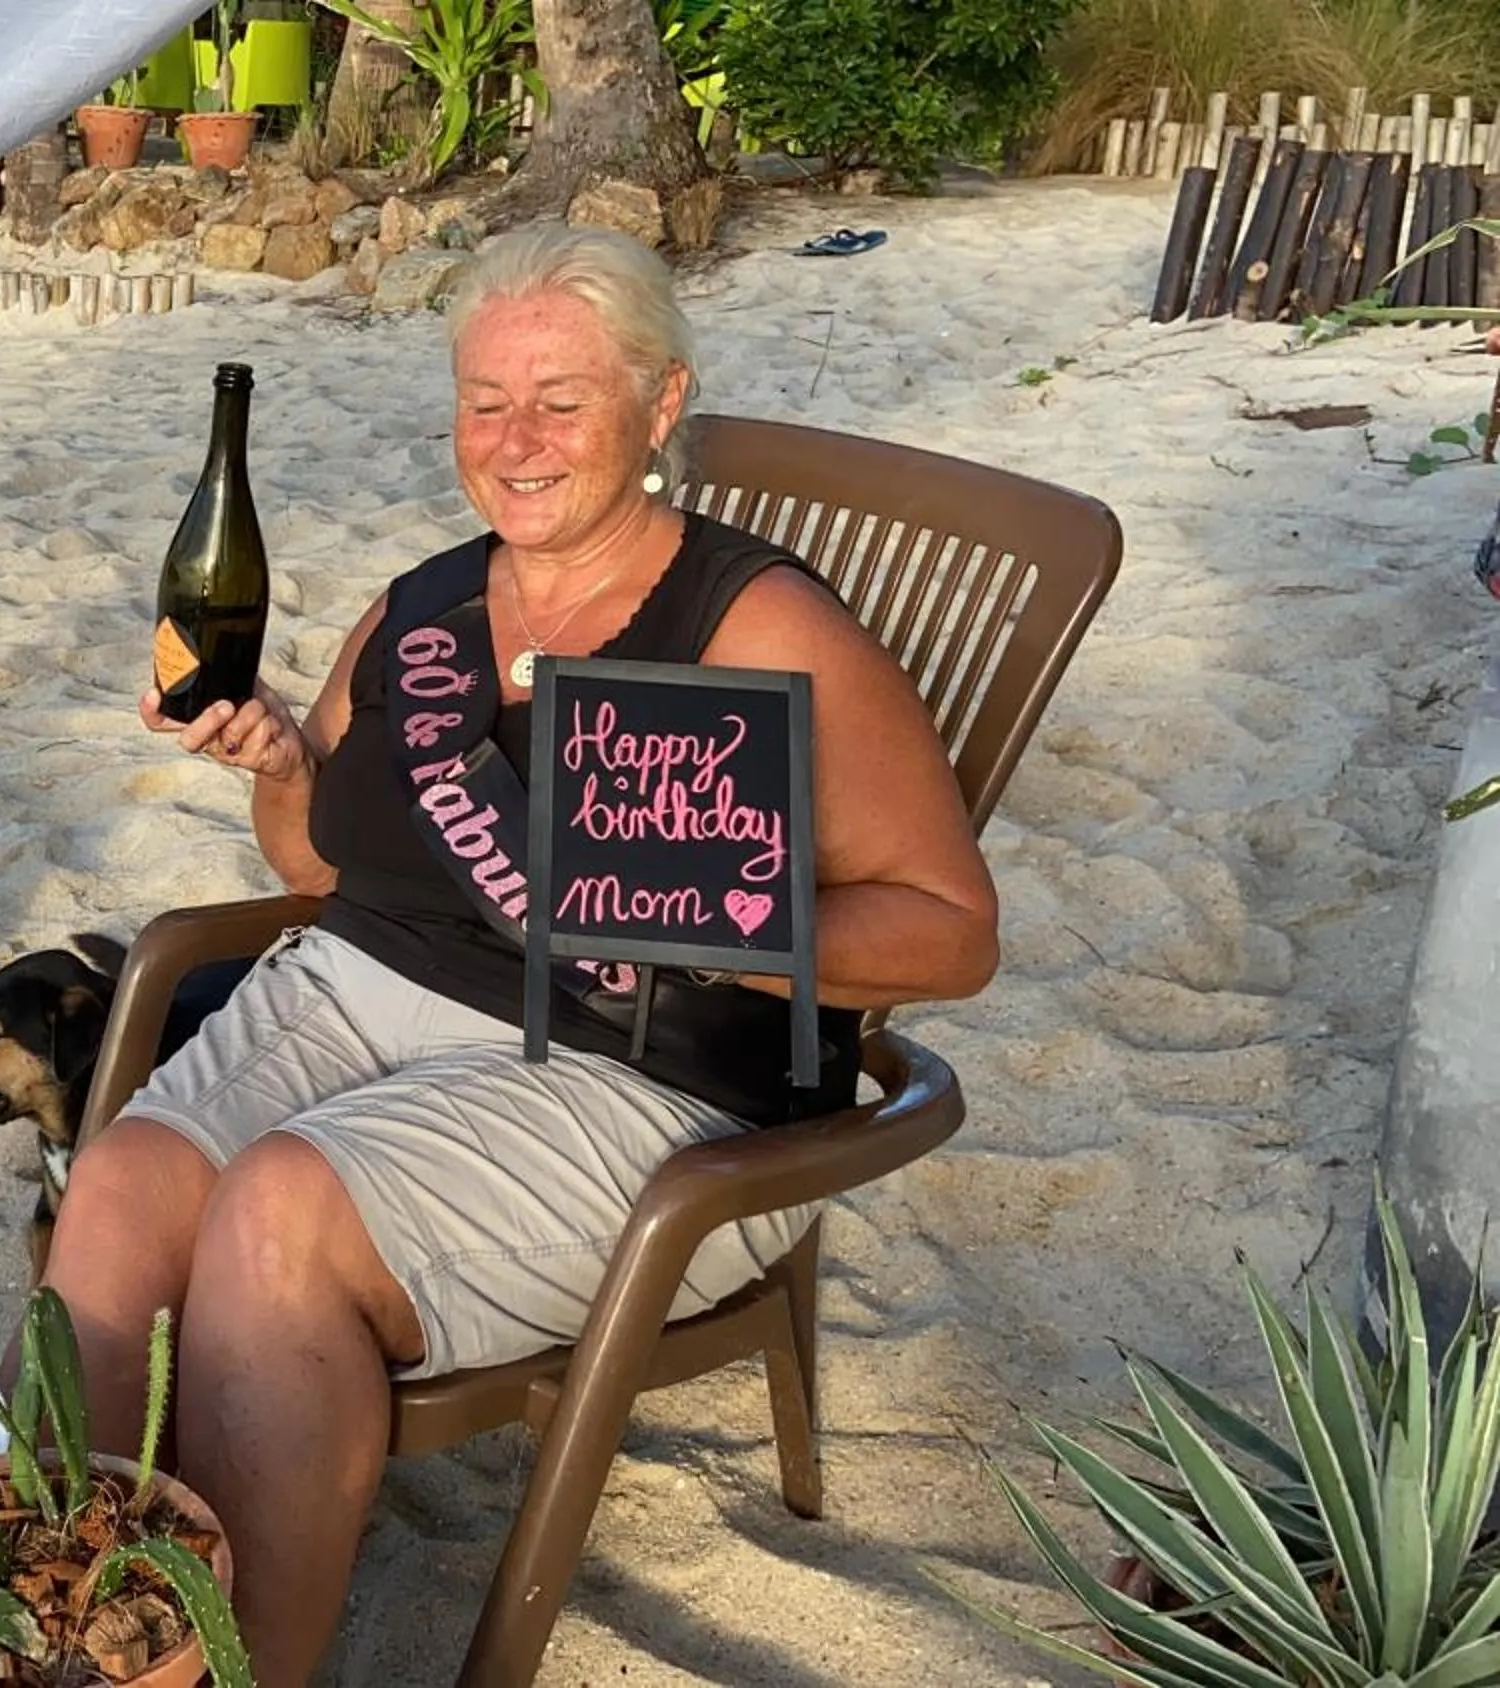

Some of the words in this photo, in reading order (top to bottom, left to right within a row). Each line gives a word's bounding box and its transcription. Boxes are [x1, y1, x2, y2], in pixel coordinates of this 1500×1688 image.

[397, 626, 460, 698] 60
[403, 711, 463, 750] &
[564, 699, 746, 796] Happy
[569, 772, 788, 882] birthday
